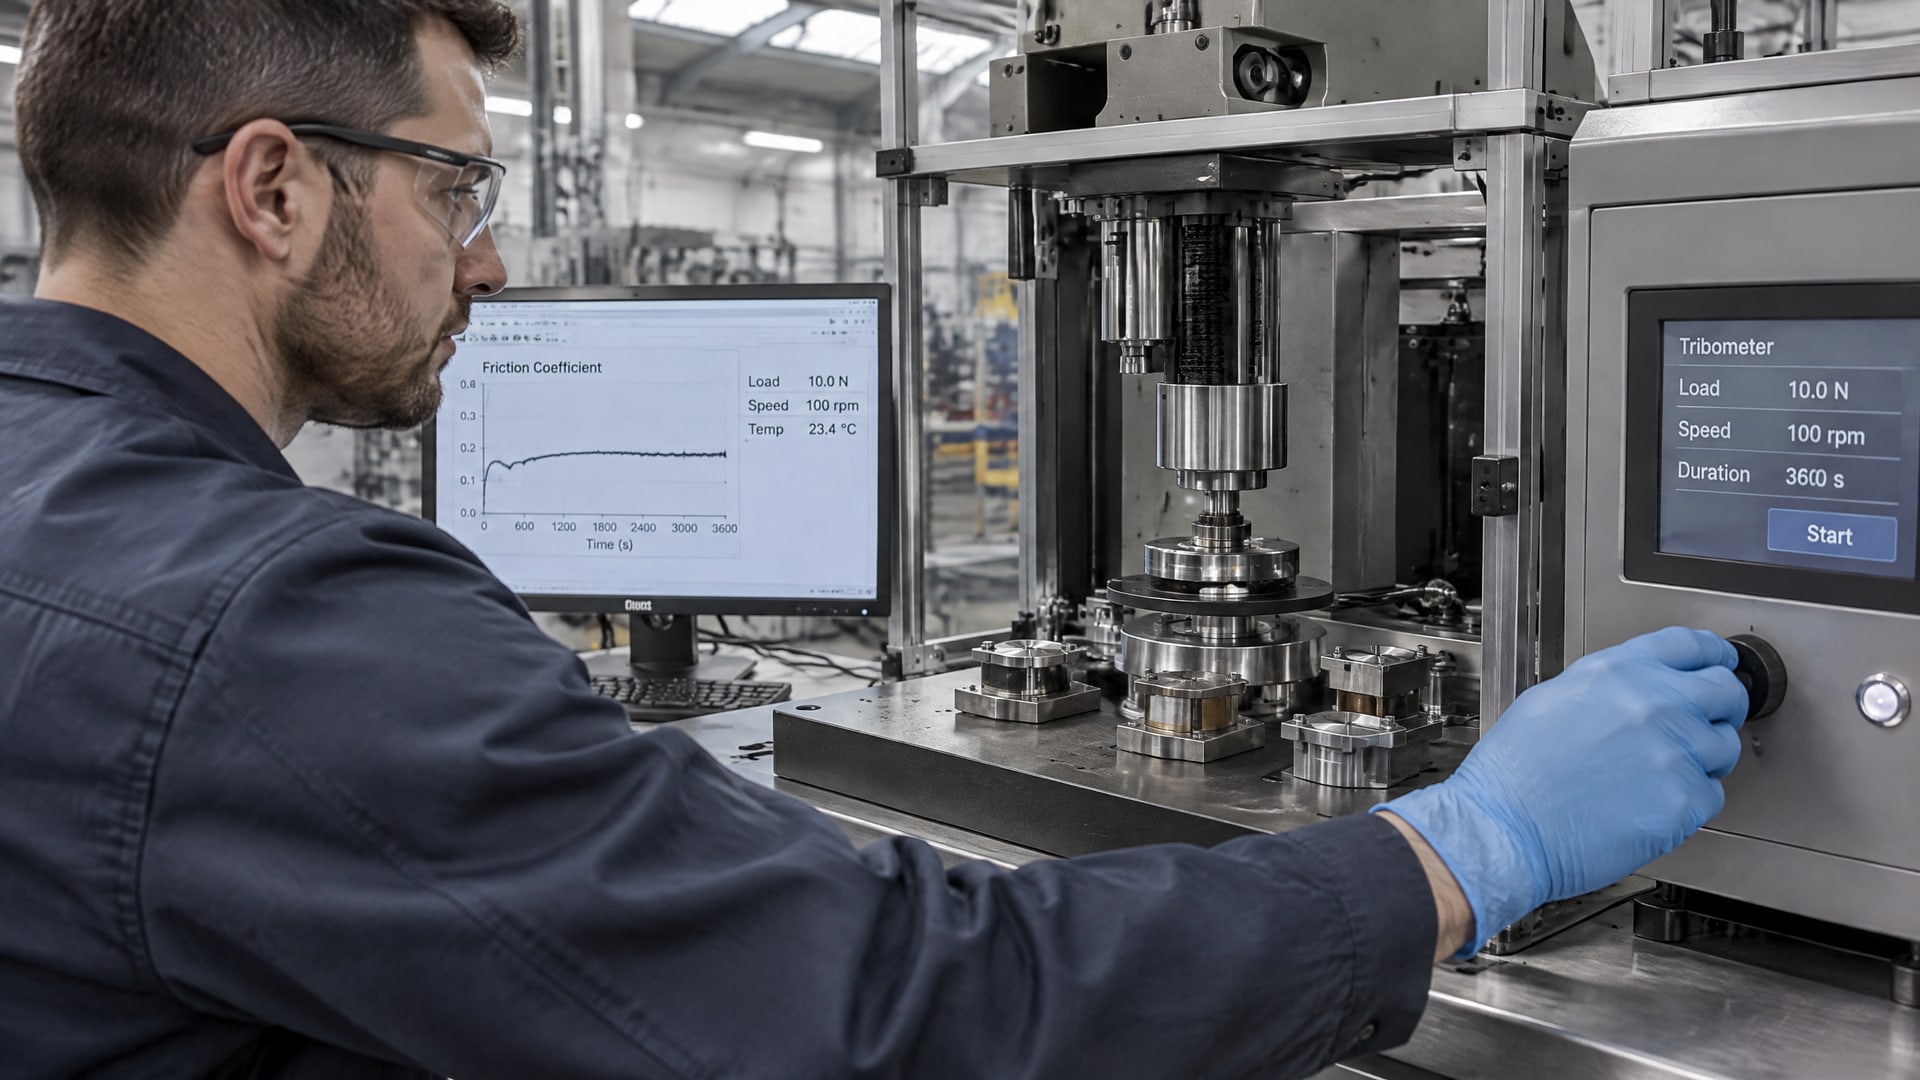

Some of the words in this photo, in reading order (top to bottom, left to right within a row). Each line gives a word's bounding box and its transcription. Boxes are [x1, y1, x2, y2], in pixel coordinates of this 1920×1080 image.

[1679, 337, 1775, 356] Tribometer
[482, 361, 530, 374] Friction
[533, 360, 602, 374] Coefficient
[748, 375, 780, 388] Load
[808, 375, 835, 388] 10.0
[838, 375, 849, 388] N
[1679, 377, 1720, 397] Load
[1788, 380, 1828, 400] 10.0
[1834, 381, 1849, 401] N
[748, 398, 789, 414] Speed
[806, 399, 830, 412] 100
[833, 401, 859, 414] rpm
[459, 410, 476, 421] 0.3
[748, 422, 784, 438] Temp
[808, 422, 836, 436] 23.4
[840, 422, 858, 436] °C
[1678, 420, 1731, 442] Speed
[1787, 423, 1822, 443] 100
[1827, 429, 1865, 449] rpm
[459, 442, 476, 453] 0.2
[459, 475, 475, 486] 0.1
[1678, 460, 1751, 483] Duration
[1833, 473, 1845, 489] s
[460, 507, 477, 518] 0.0
[480, 520, 488, 531] 0
[514, 521, 535, 532] 600
[551, 521, 577, 532] 1200
[592, 521, 618, 532] 1800
[630, 522, 657, 533] 2400
[671, 522, 698, 534] 3000
[712, 523, 738, 534] 3600
[1807, 524, 1854, 546] Start
[585, 538, 615, 550] Time
[618, 538, 634, 552] (s)
